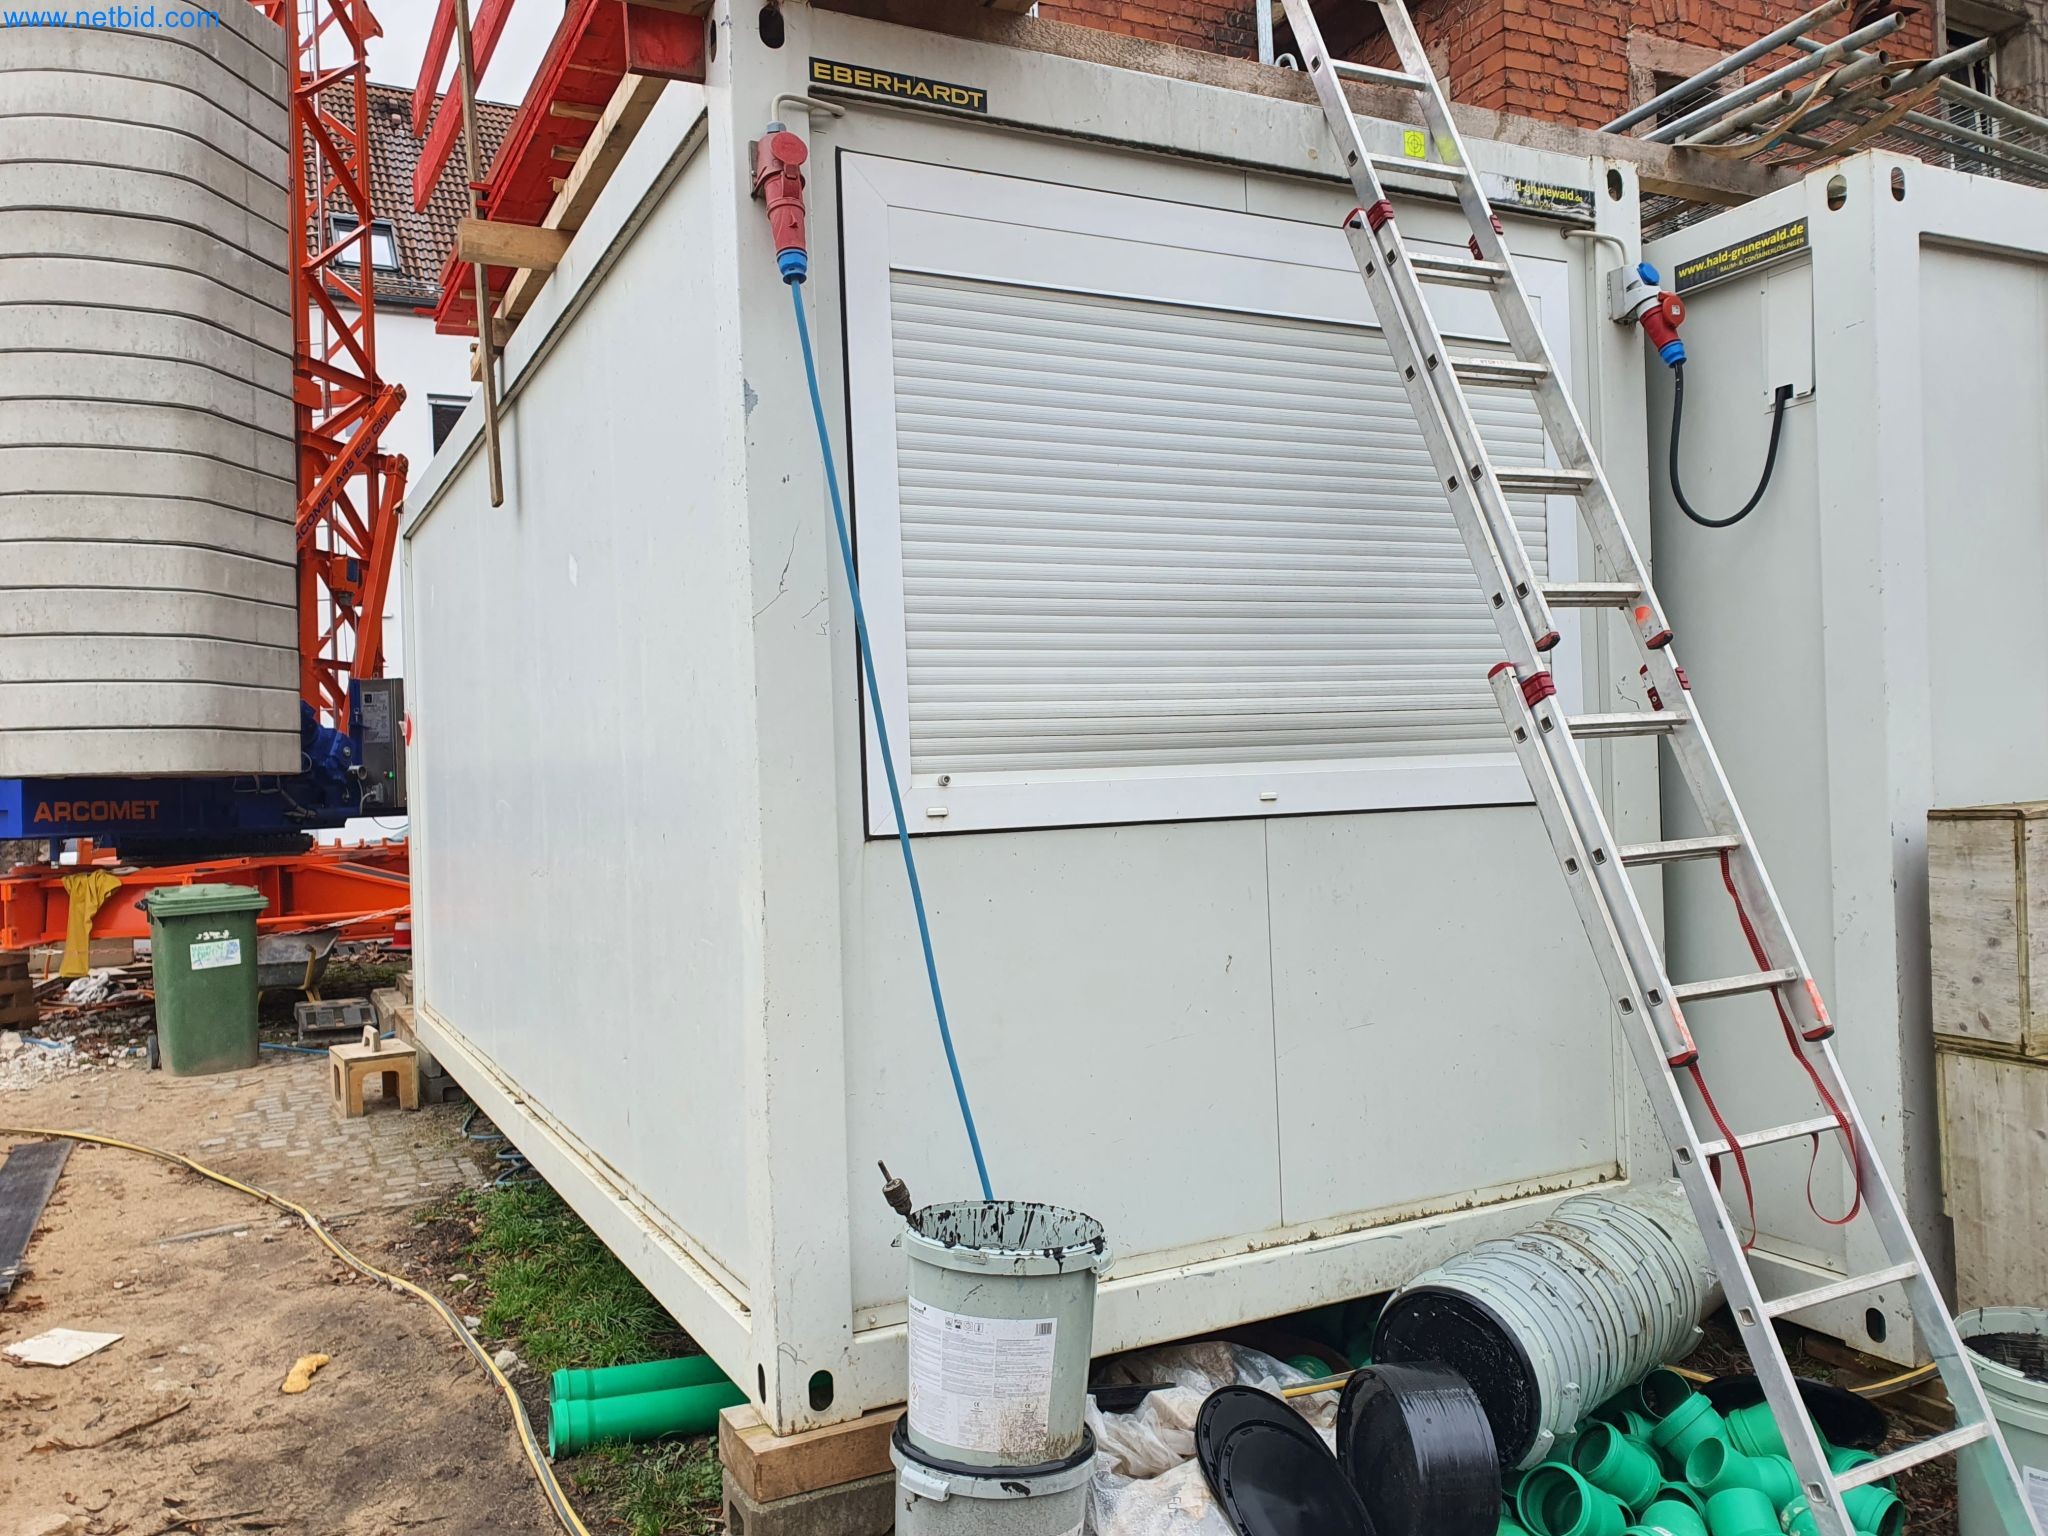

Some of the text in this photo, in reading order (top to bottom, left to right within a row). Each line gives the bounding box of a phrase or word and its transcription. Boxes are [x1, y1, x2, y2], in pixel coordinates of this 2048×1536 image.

[813, 61, 984, 108] EBERHARDT
[1678, 223, 1804, 278] www.hald-grunewald.de
[354, 437, 372, 458] Eco
[371, 411, 390, 435] City
[33, 799, 160, 823] ARCOMET
